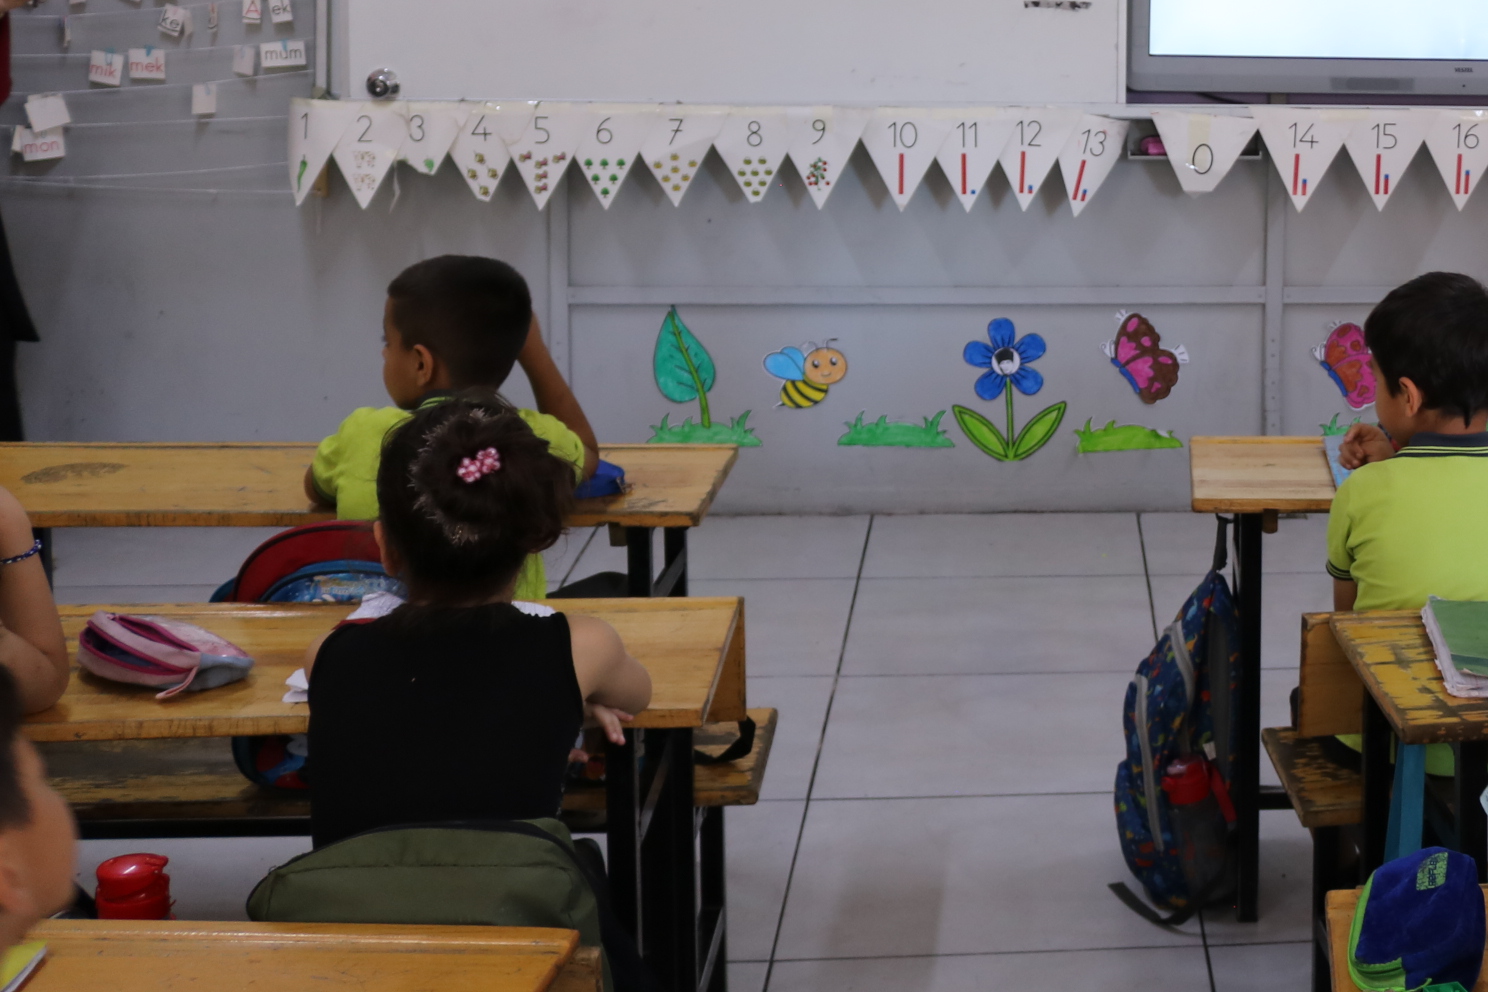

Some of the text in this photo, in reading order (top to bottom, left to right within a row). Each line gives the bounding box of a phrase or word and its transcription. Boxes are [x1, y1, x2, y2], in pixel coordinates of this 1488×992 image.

[272, 1, 292, 14] ek
[90, 49, 303, 78] mik mek mum
[301, 113, 308, 139] 1
[357, 115, 372, 142] 2
[410, 115, 424, 141] 3
[472, 115, 492, 141] 4
[534, 116, 549, 143] 5
[596, 118, 612, 144] 6
[669, 119, 683, 145] 7
[747, 121, 762, 146] 8
[812, 120, 826, 144] 9
[888, 122, 917, 148] 10
[957, 122, 977, 148] 11
[1016, 120, 1042, 147] 12
[1080, 129, 1107, 156] 13
[1193, 144, 1213, 174] 0
[1289, 123, 1318, 149] 14
[1371, 123, 1397, 148] 15
[1453, 122, 1479, 149] 16
